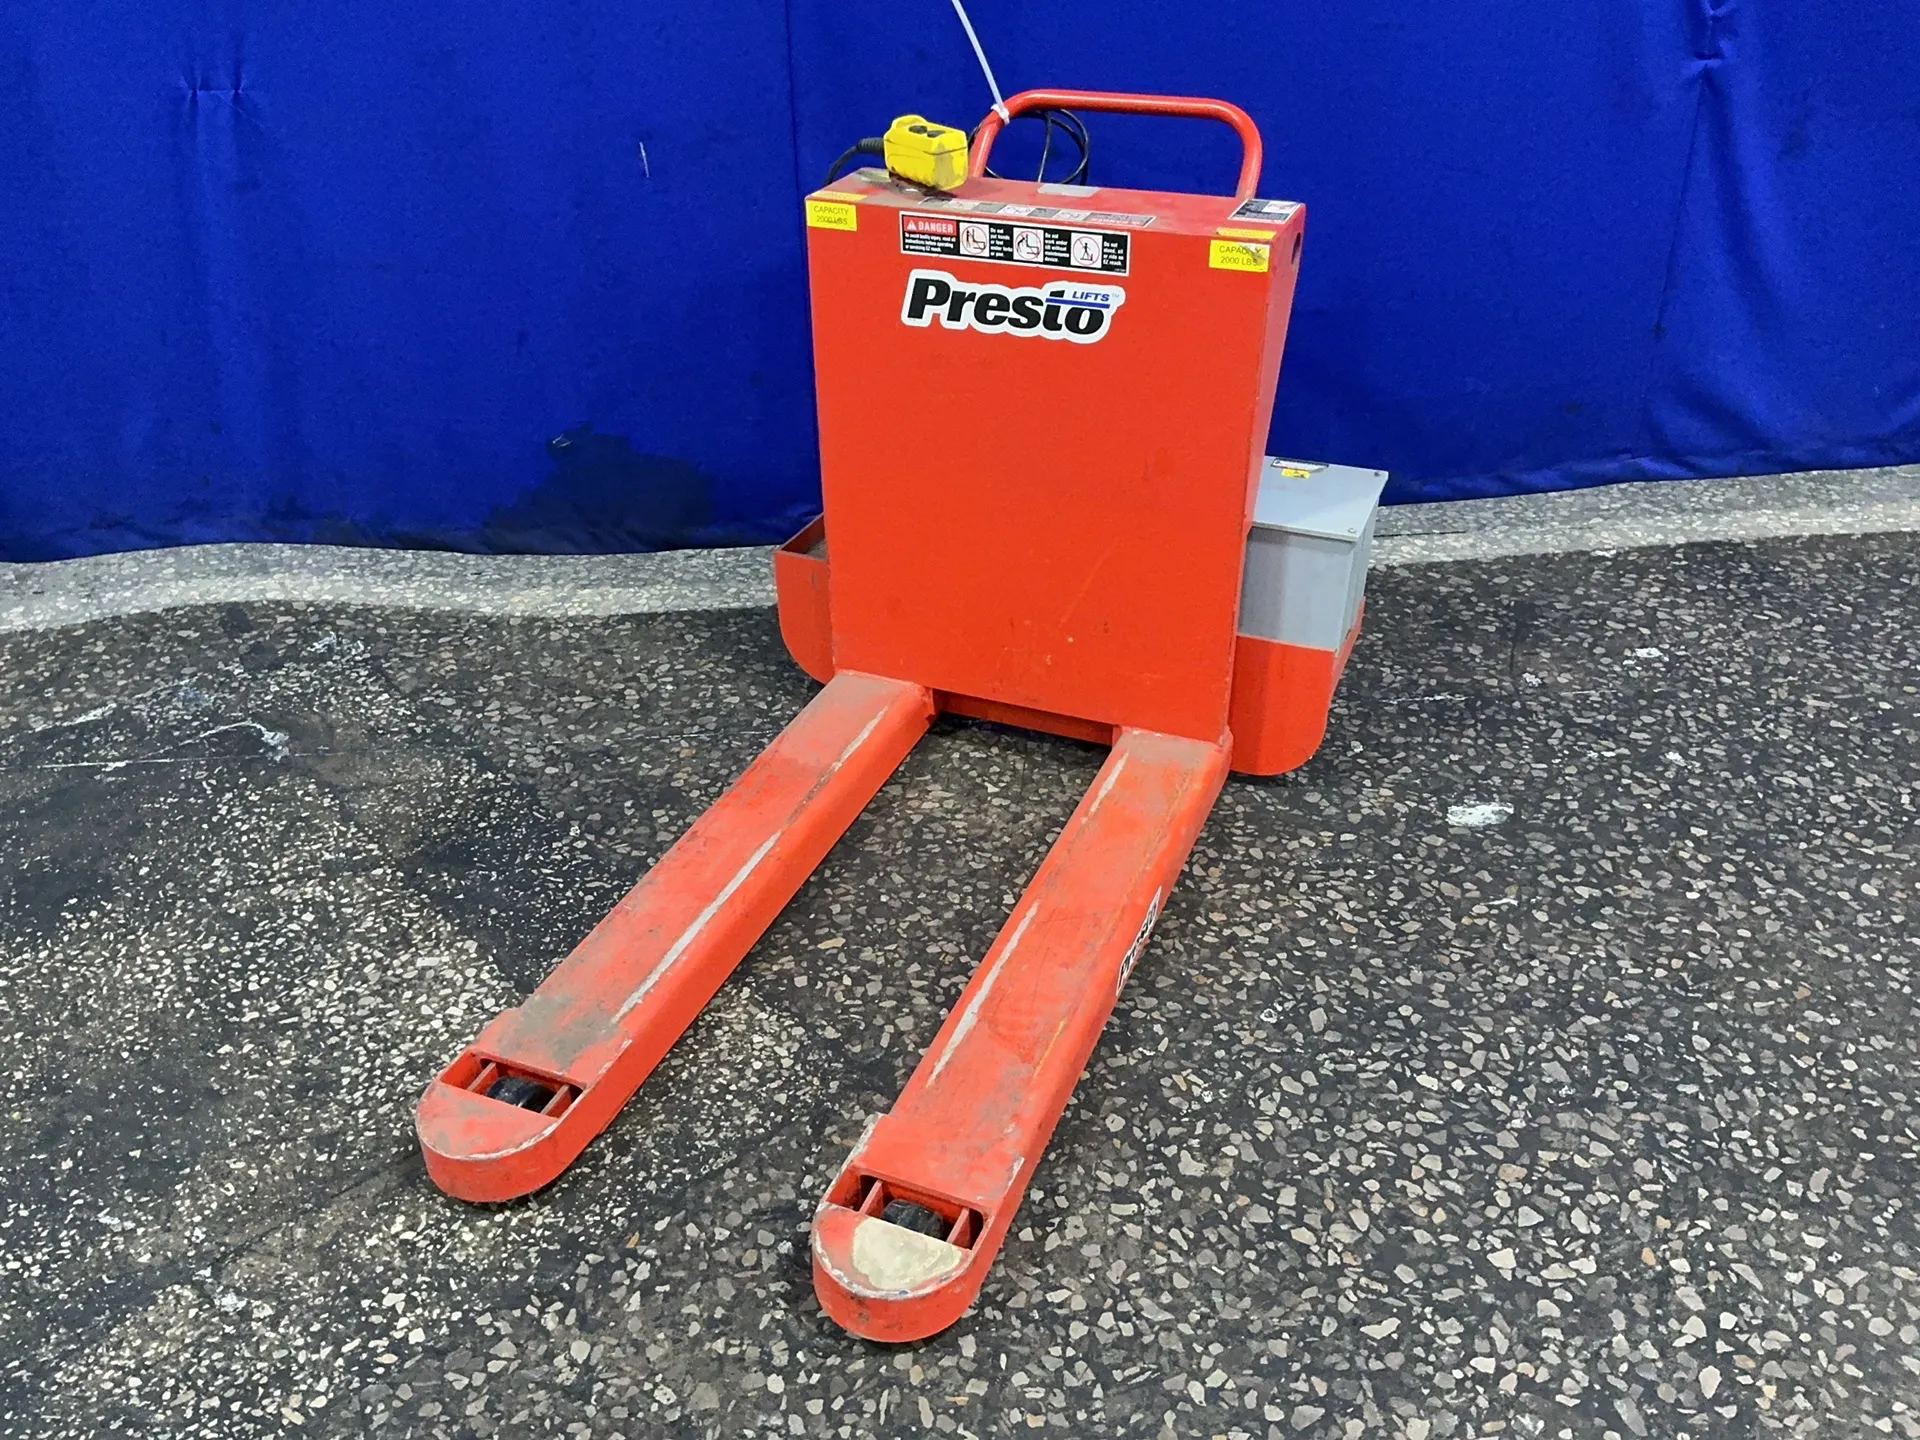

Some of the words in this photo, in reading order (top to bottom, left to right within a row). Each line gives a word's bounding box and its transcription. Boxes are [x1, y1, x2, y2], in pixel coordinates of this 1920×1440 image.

[813, 205, 849, 214] CAPACITY
[918, 221, 954, 233] DANGER
[1220, 256, 1239, 264] 2000
[1072, 291, 1110, 301] LIFTS
[907, 278, 1104, 335] Presto
